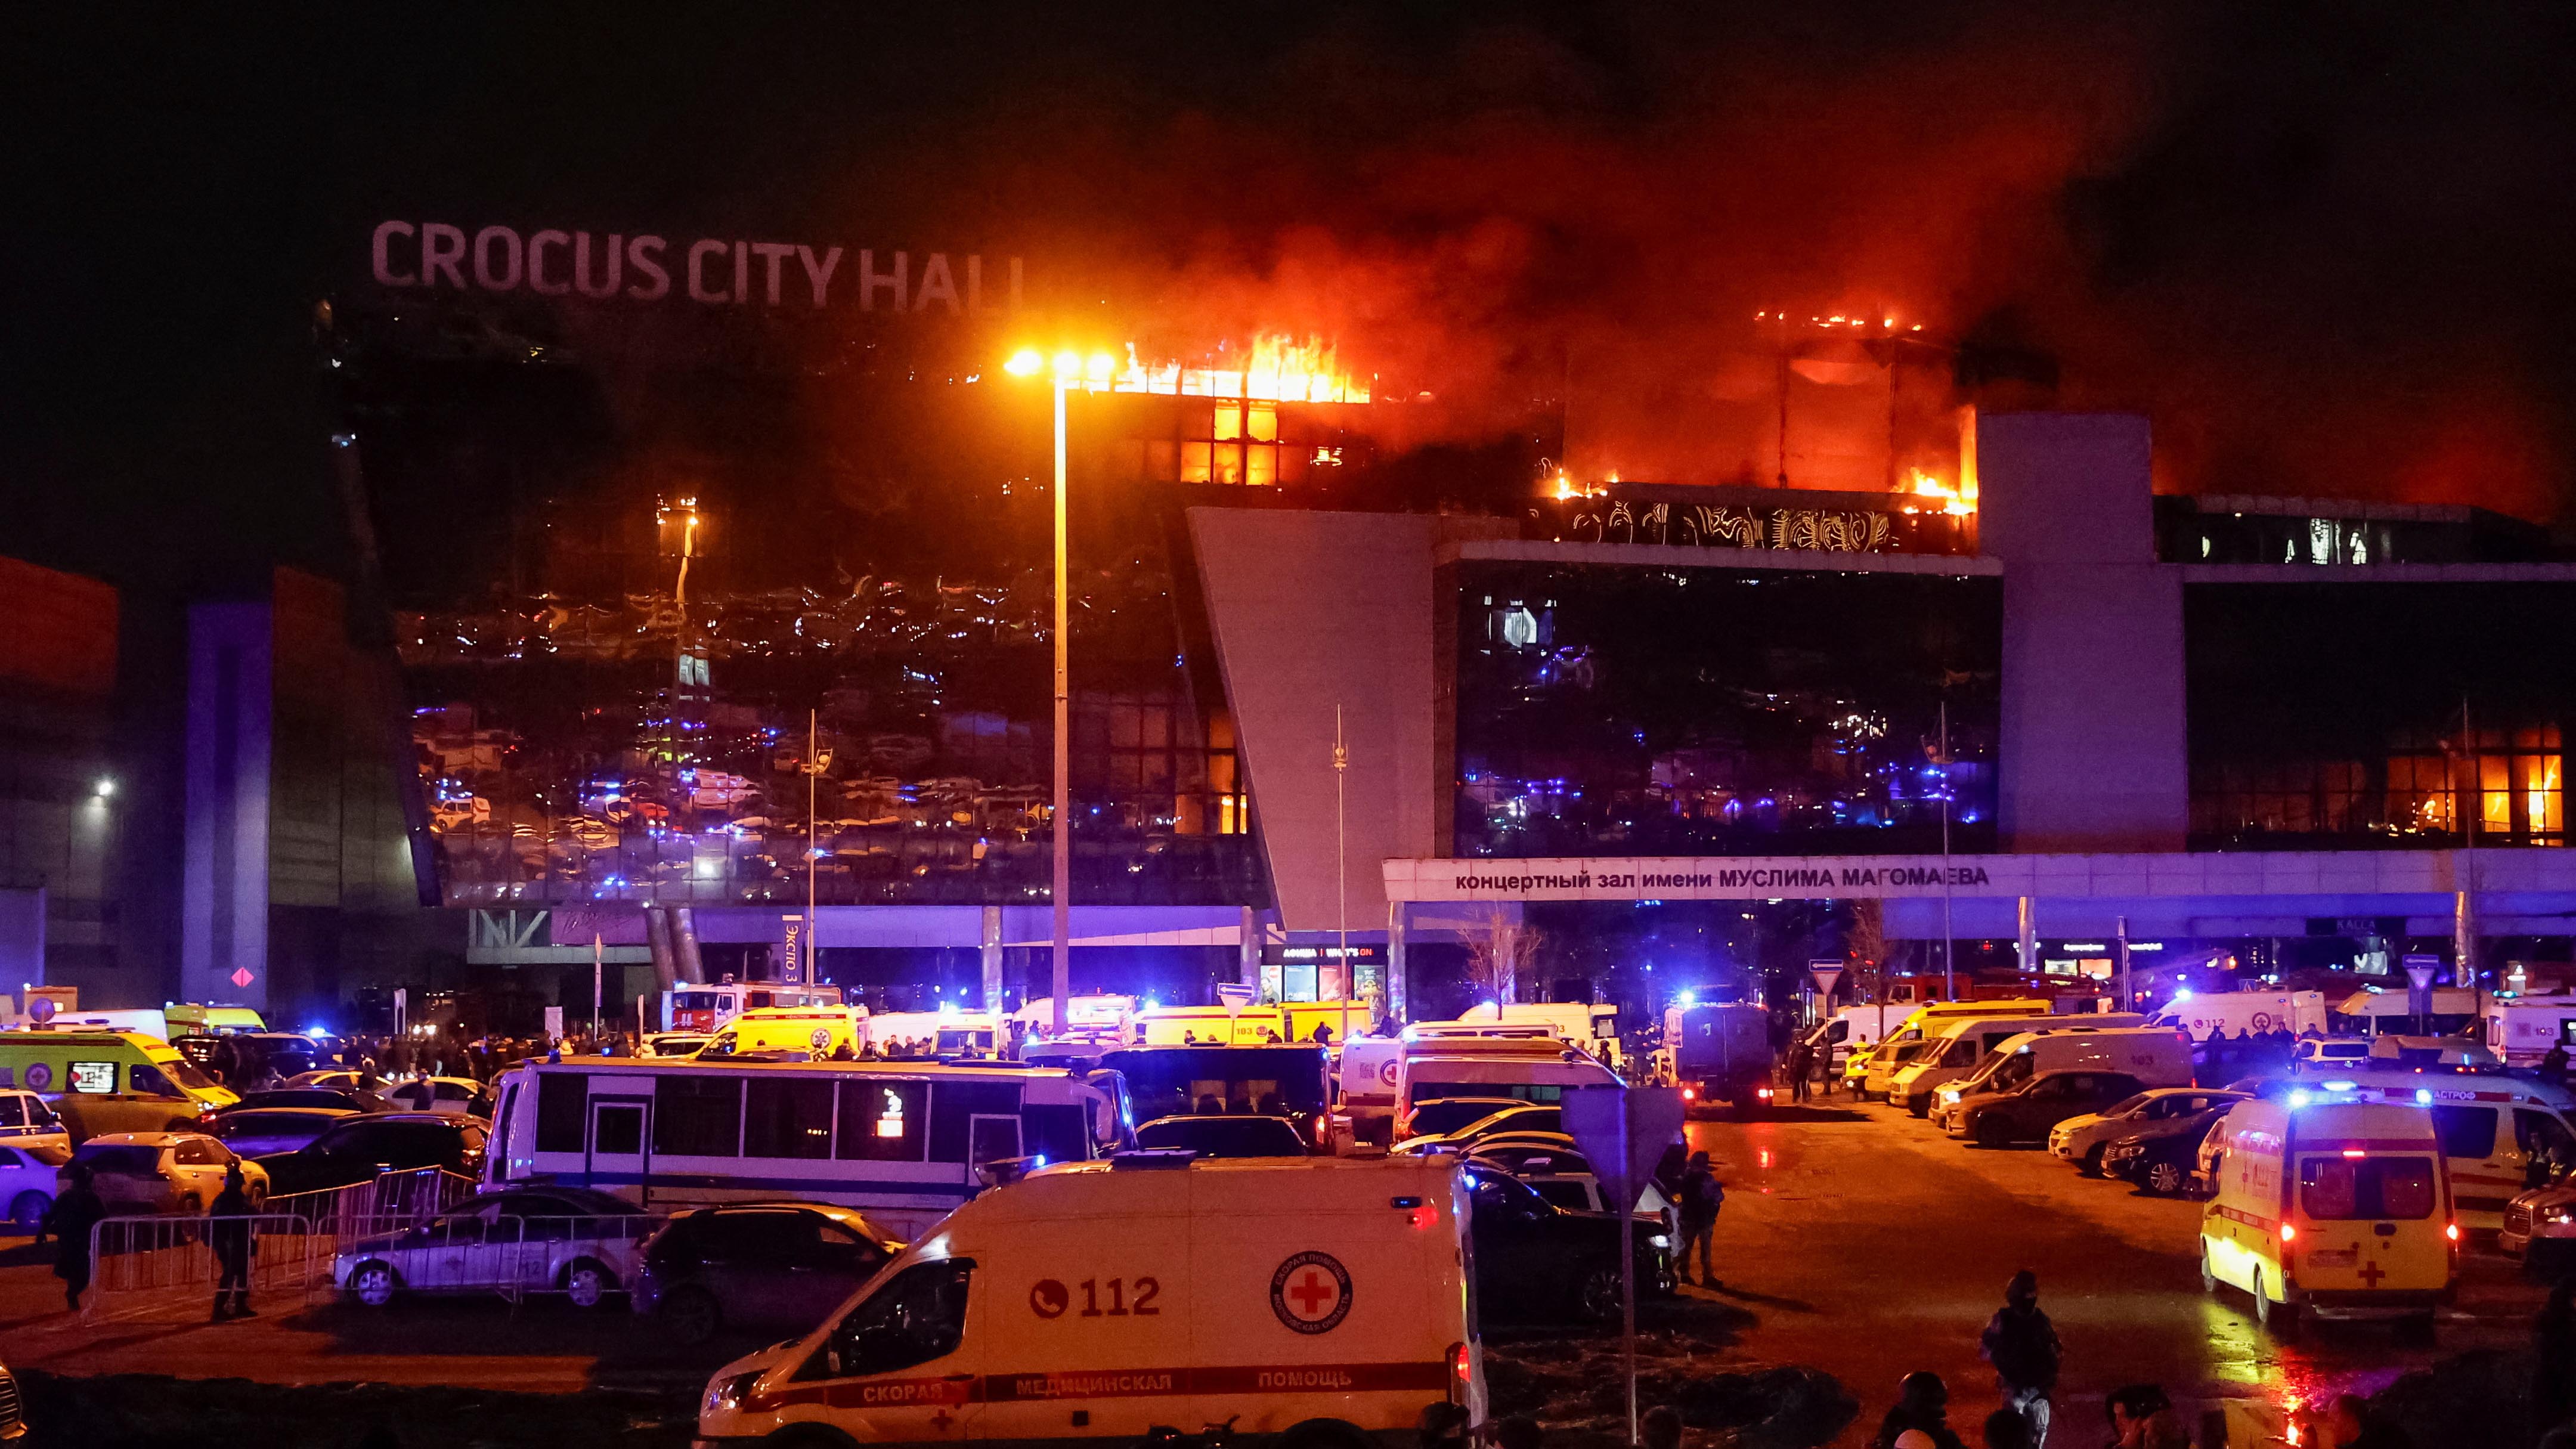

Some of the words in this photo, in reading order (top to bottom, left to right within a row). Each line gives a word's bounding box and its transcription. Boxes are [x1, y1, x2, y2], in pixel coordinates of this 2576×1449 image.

[373, 220, 670, 298] CROCUS
[688, 239, 844, 309] CITY
[1456, 869, 1590, 893] концертный
[1598, 873, 1635, 888] зал
[1642, 872, 1712, 888] имени
[1720, 868, 1835, 887] МУСЛИМА
[1842, 868, 1989, 886] МАГОМАЕВА
[785, 974, 798, 982] 3
[2206, 1018, 2225, 1028] 112
[2434, 1091, 2476, 1100] АСТРОФ
[1080, 1277, 1160, 1317] 112
[863, 1383, 943, 1402] СКОРАЯ
[1016, 1374, 1172, 1396] МЕДИЦИНСКАЯ
[1259, 1371, 1352, 1388] ПОМОЩЬ
